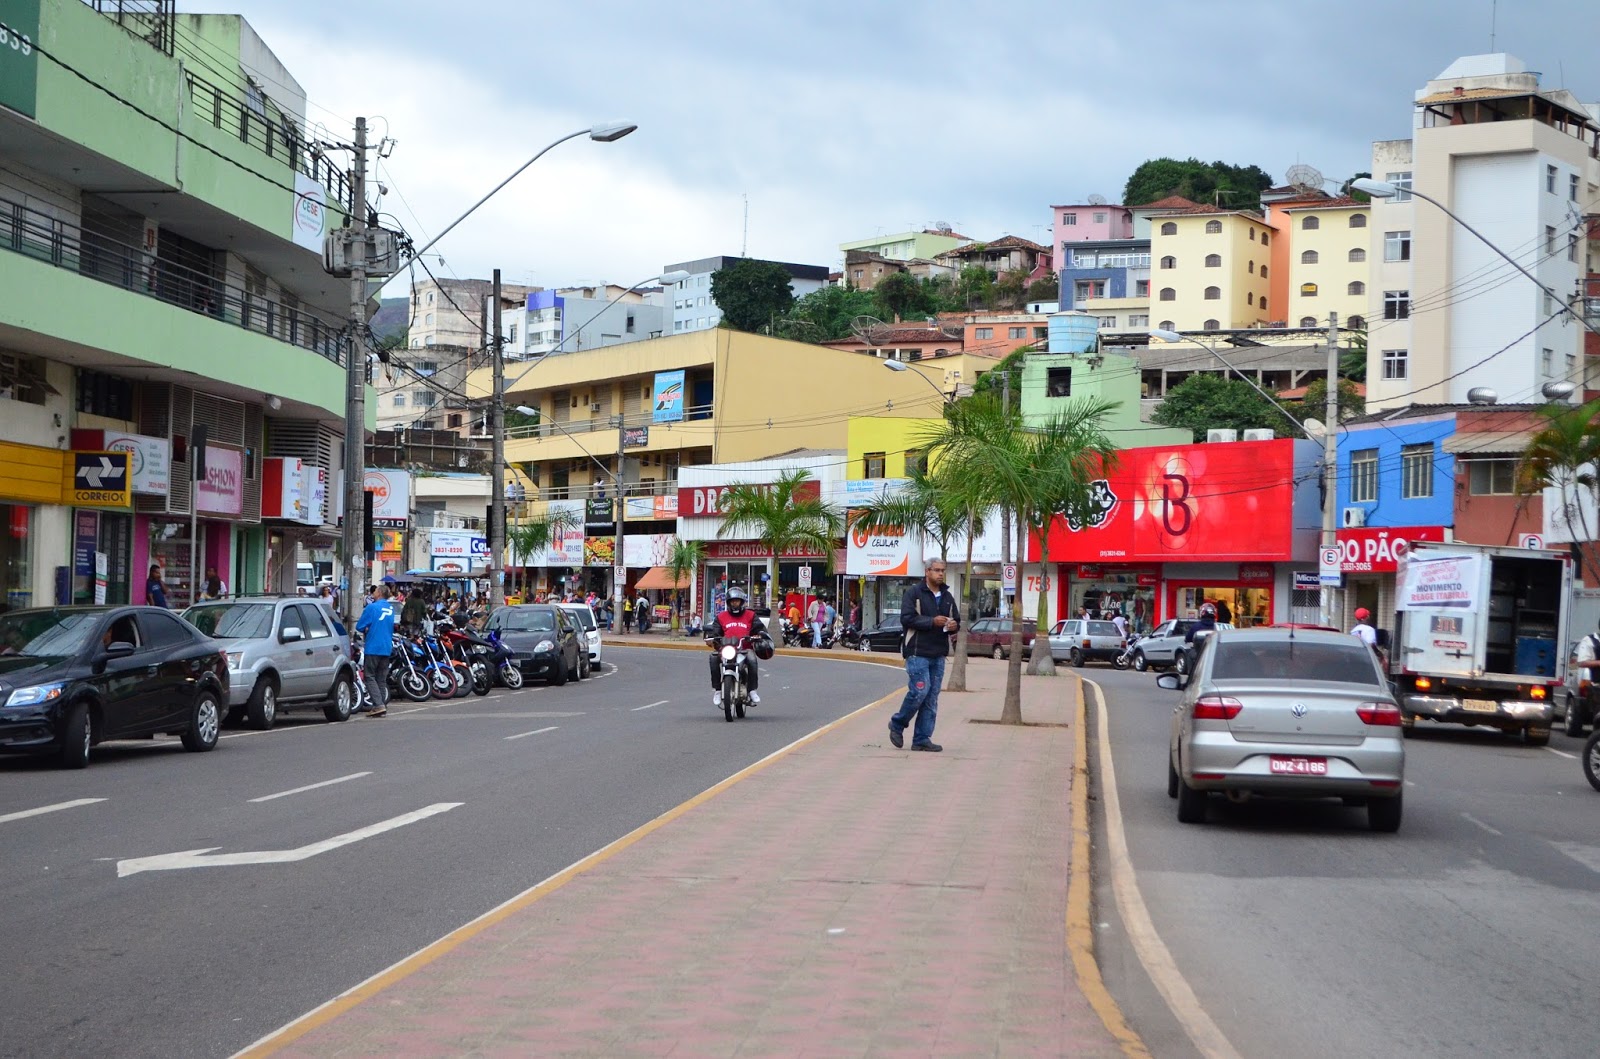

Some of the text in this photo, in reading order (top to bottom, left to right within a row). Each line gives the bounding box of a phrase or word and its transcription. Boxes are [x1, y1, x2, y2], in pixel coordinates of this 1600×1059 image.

[302, 199, 318, 216] CESE
[205, 466, 235, 487] ASHION
[871, 539, 899, 548] CELULAR
[718, 544, 768, 557] DESCONTOS
[1327, 552, 1333, 562] E
[1296, 573, 1320, 582] Micro
[1416, 583, 1462, 592] MOVIMENTO
[1411, 591, 1469, 601] REAGE ITABIRA!
